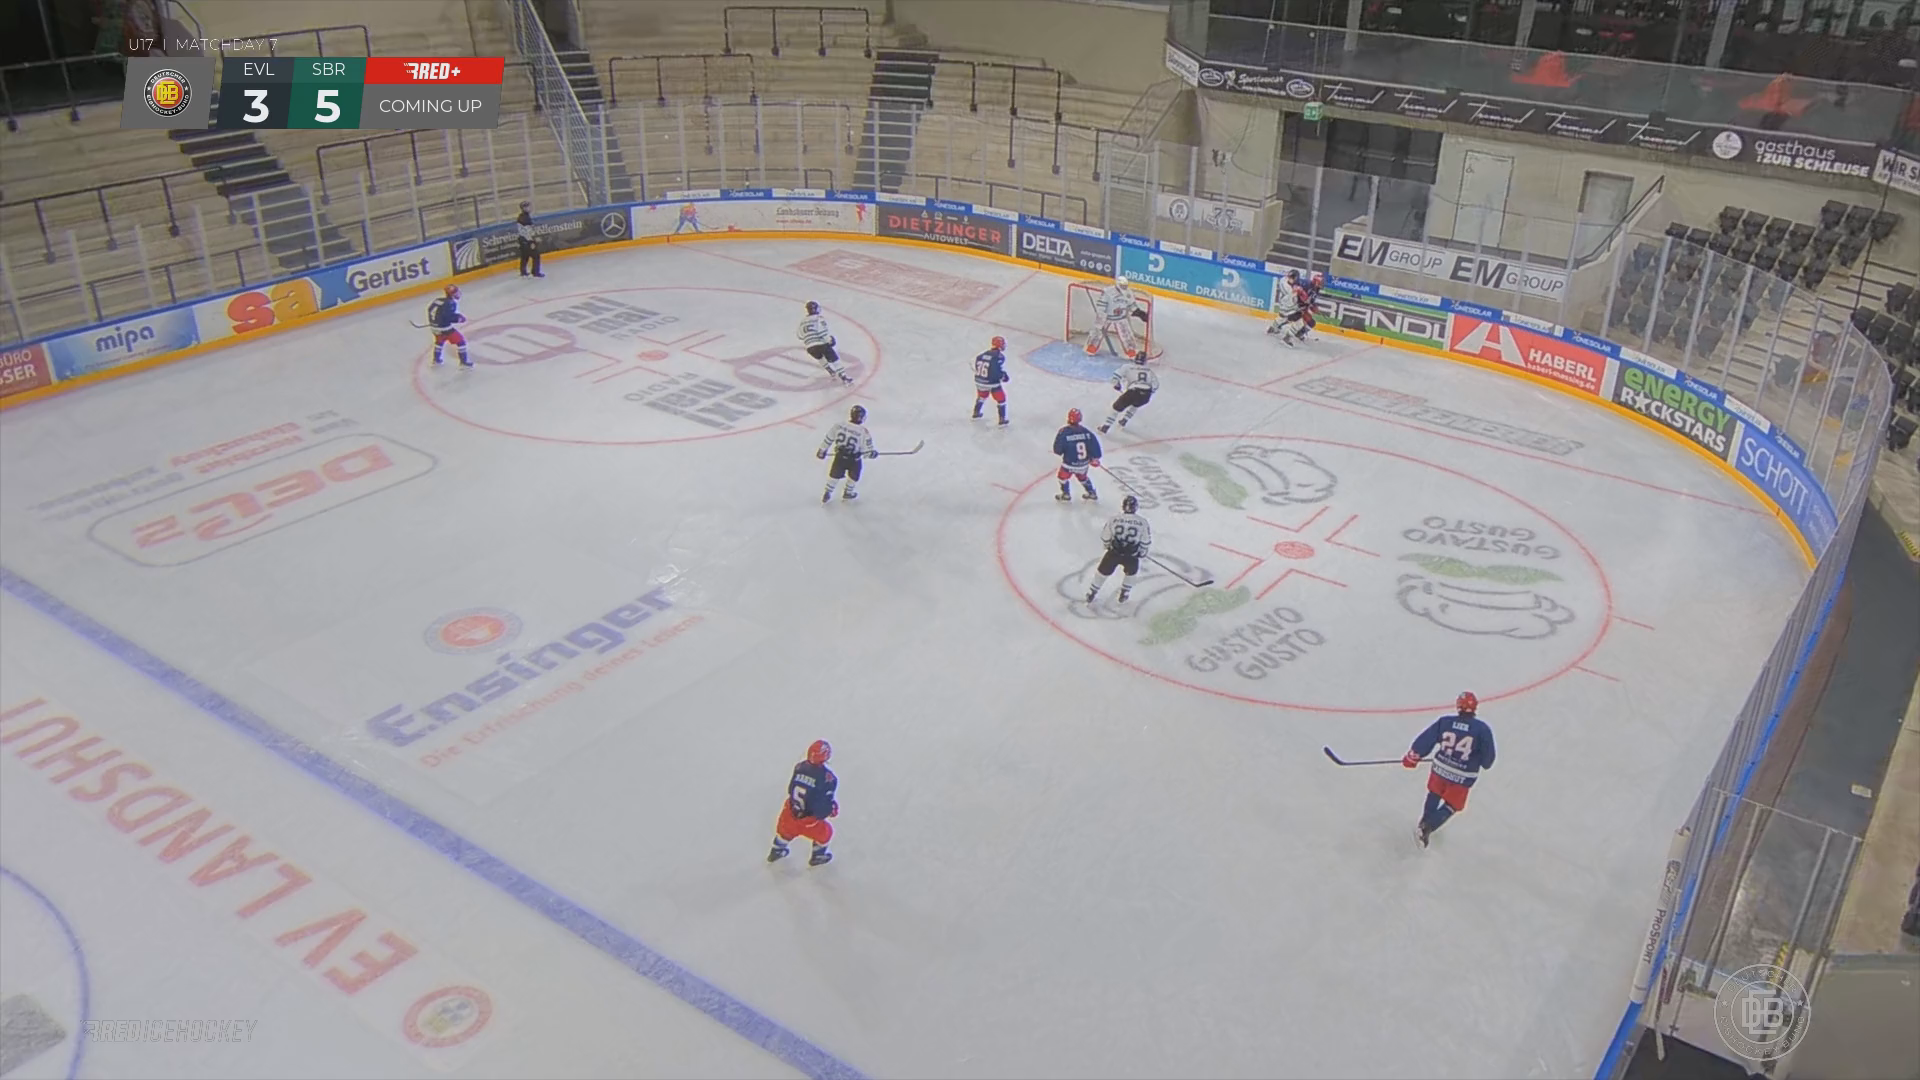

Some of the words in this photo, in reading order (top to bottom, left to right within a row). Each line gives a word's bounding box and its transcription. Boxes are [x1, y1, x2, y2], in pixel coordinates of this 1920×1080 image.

[1755, 140, 1836, 160] gasthaus
[1794, 156, 1870, 178] SCHLEUSE
[888, 215, 1002, 243] DIETZINGER
[923, 233, 969, 245] AUTOWELT
[1022, 232, 1075, 259] DELTA
[1337, 234, 1390, 266] EM
[349, 257, 430, 293] Gerüst
[1450, 255, 1508, 289] EM
[1506, 272, 1564, 292] GROUP
[1313, 299, 1446, 341] RANDL
[95, 324, 155, 353] mipa
[1529, 348, 1597, 383] HABERL
[1076, 441, 1087, 460] 9
[1129, 456, 1199, 514] GUSTAVO
[1740, 437, 1808, 515] SCHOTT
[1114, 525, 1138, 545] 22
[1402, 528, 1562, 560] GUSTAVO
[1423, 516, 1536, 541] GUSTO
[1185, 607, 1304, 672] GUSTAVO
[1233, 628, 1327, 681] GUSTO
[364, 585, 675, 748] Ensinger
[1441, 731, 1474, 761] 24
[792, 785, 807, 810] 5
[274, 907, 419, 995] EV
[1641, 908, 1667, 965] PROSPORT
